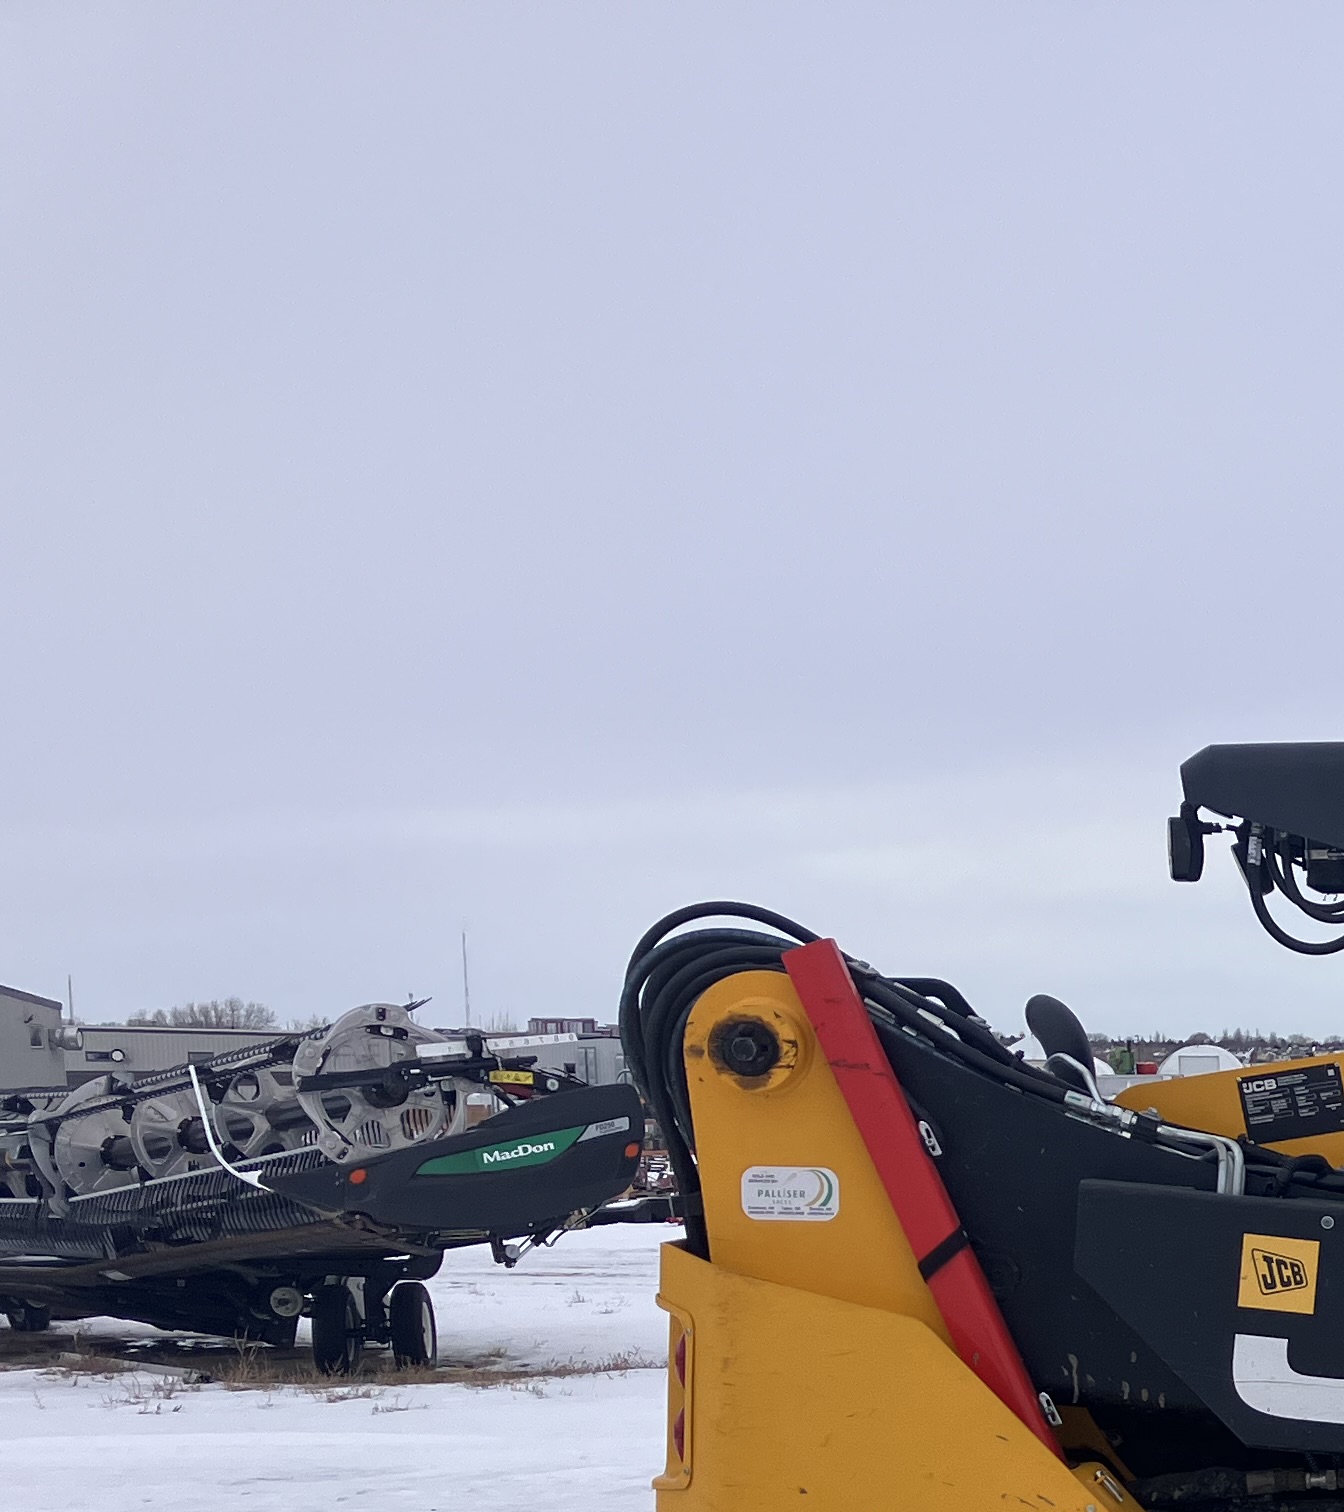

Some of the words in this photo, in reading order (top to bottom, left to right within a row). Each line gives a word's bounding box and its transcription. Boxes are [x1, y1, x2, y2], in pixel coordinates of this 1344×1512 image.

[1242, 1079, 1277, 1094] JCB
[482, 1142, 555, 1164] MacDon
[1261, 1254, 1305, 1290] JCB
